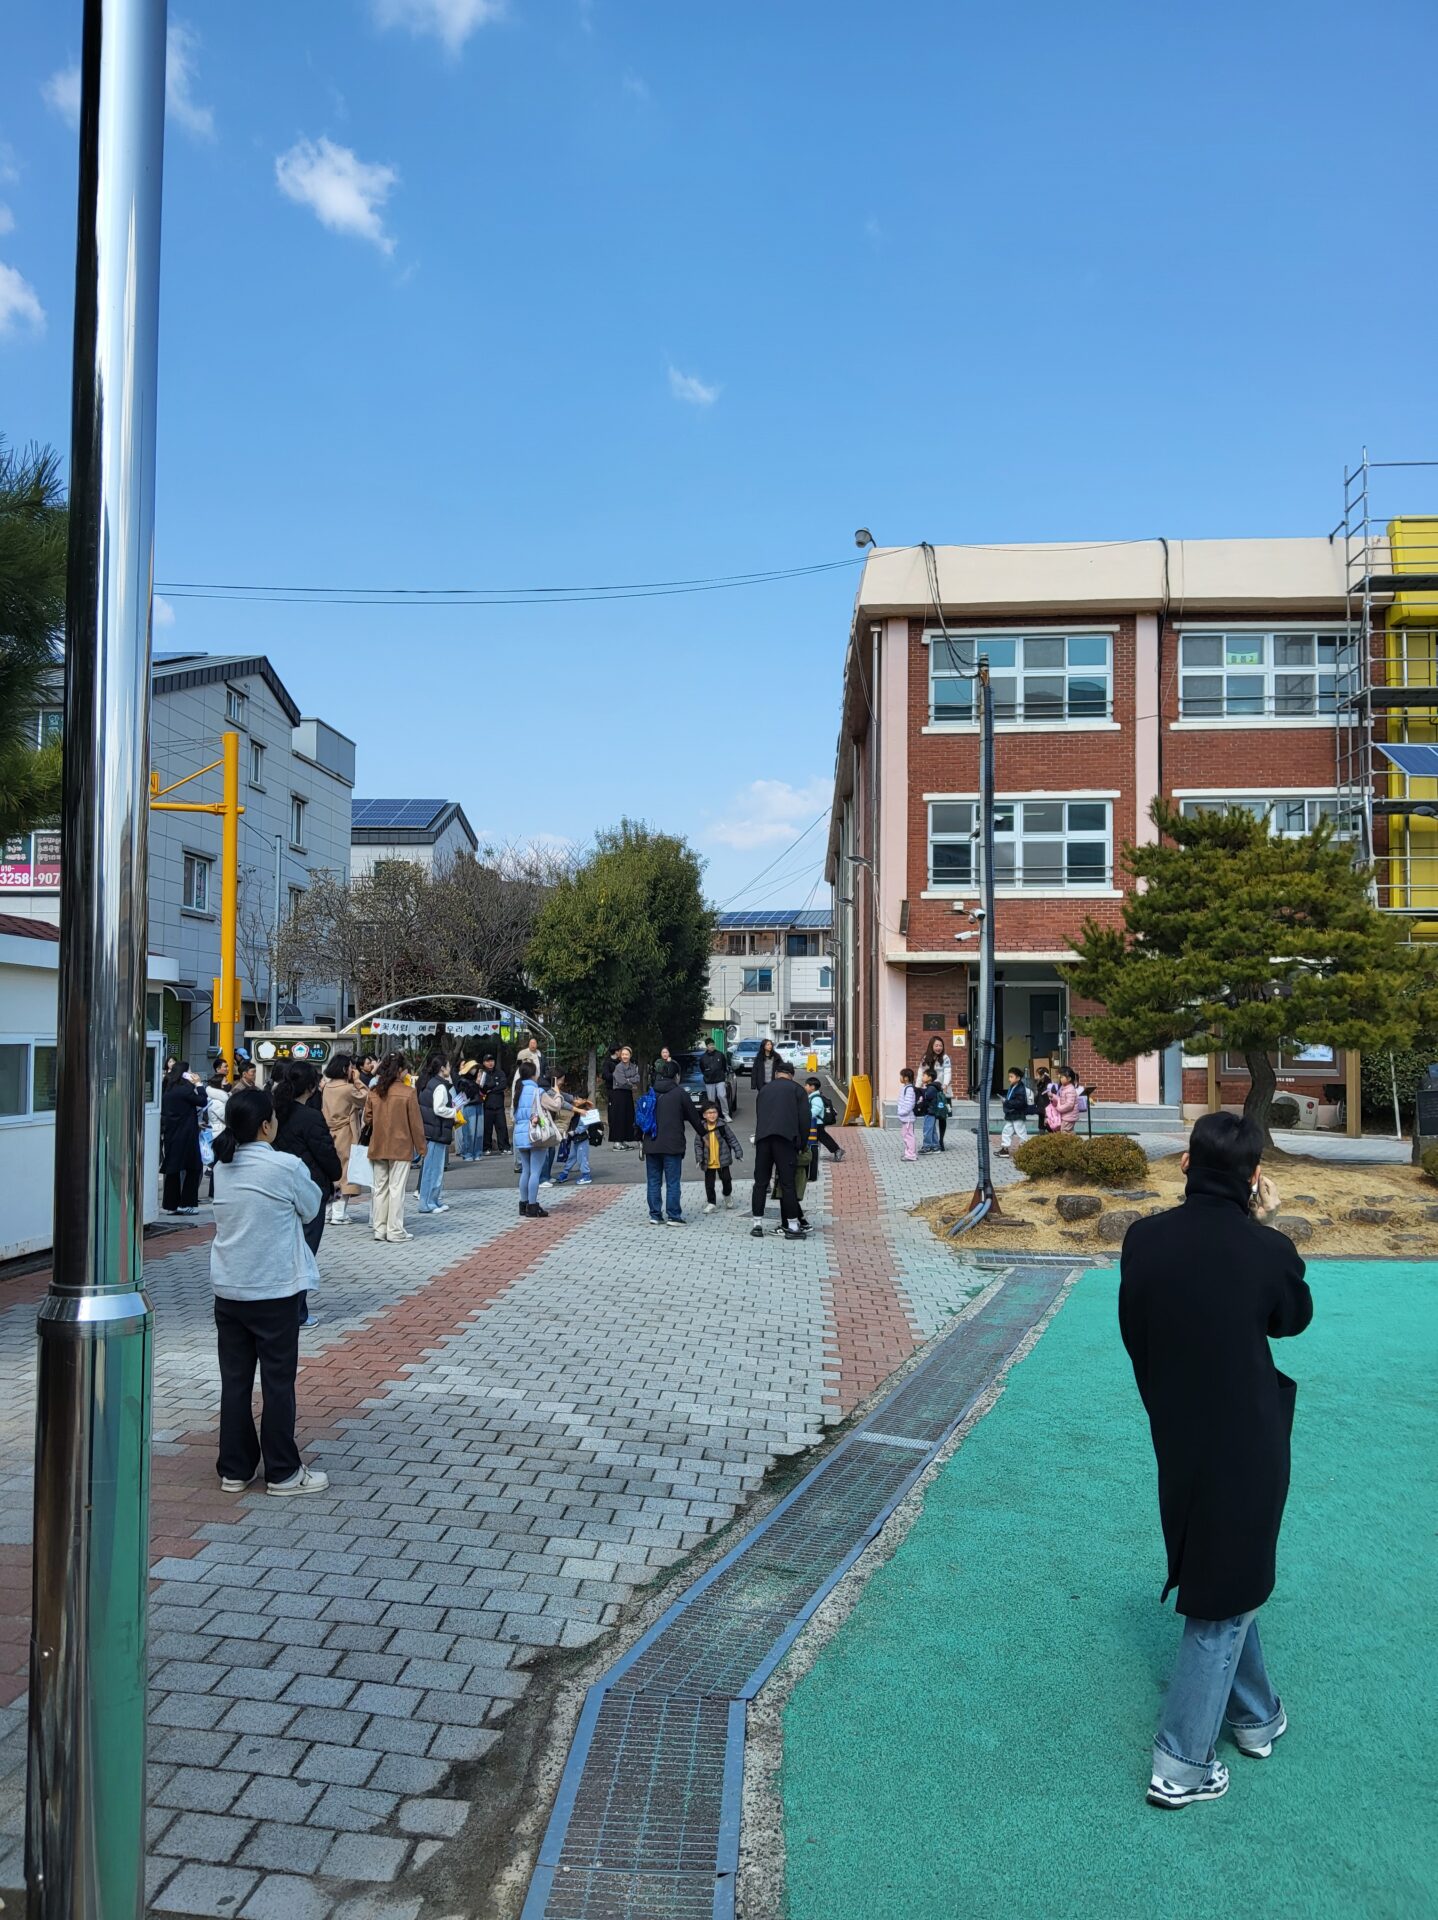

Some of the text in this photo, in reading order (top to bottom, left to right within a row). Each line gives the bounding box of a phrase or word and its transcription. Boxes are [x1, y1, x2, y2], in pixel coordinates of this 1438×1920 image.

[382, 1022, 490, 1033] 꽃처럼 예쁜 우리 학교
